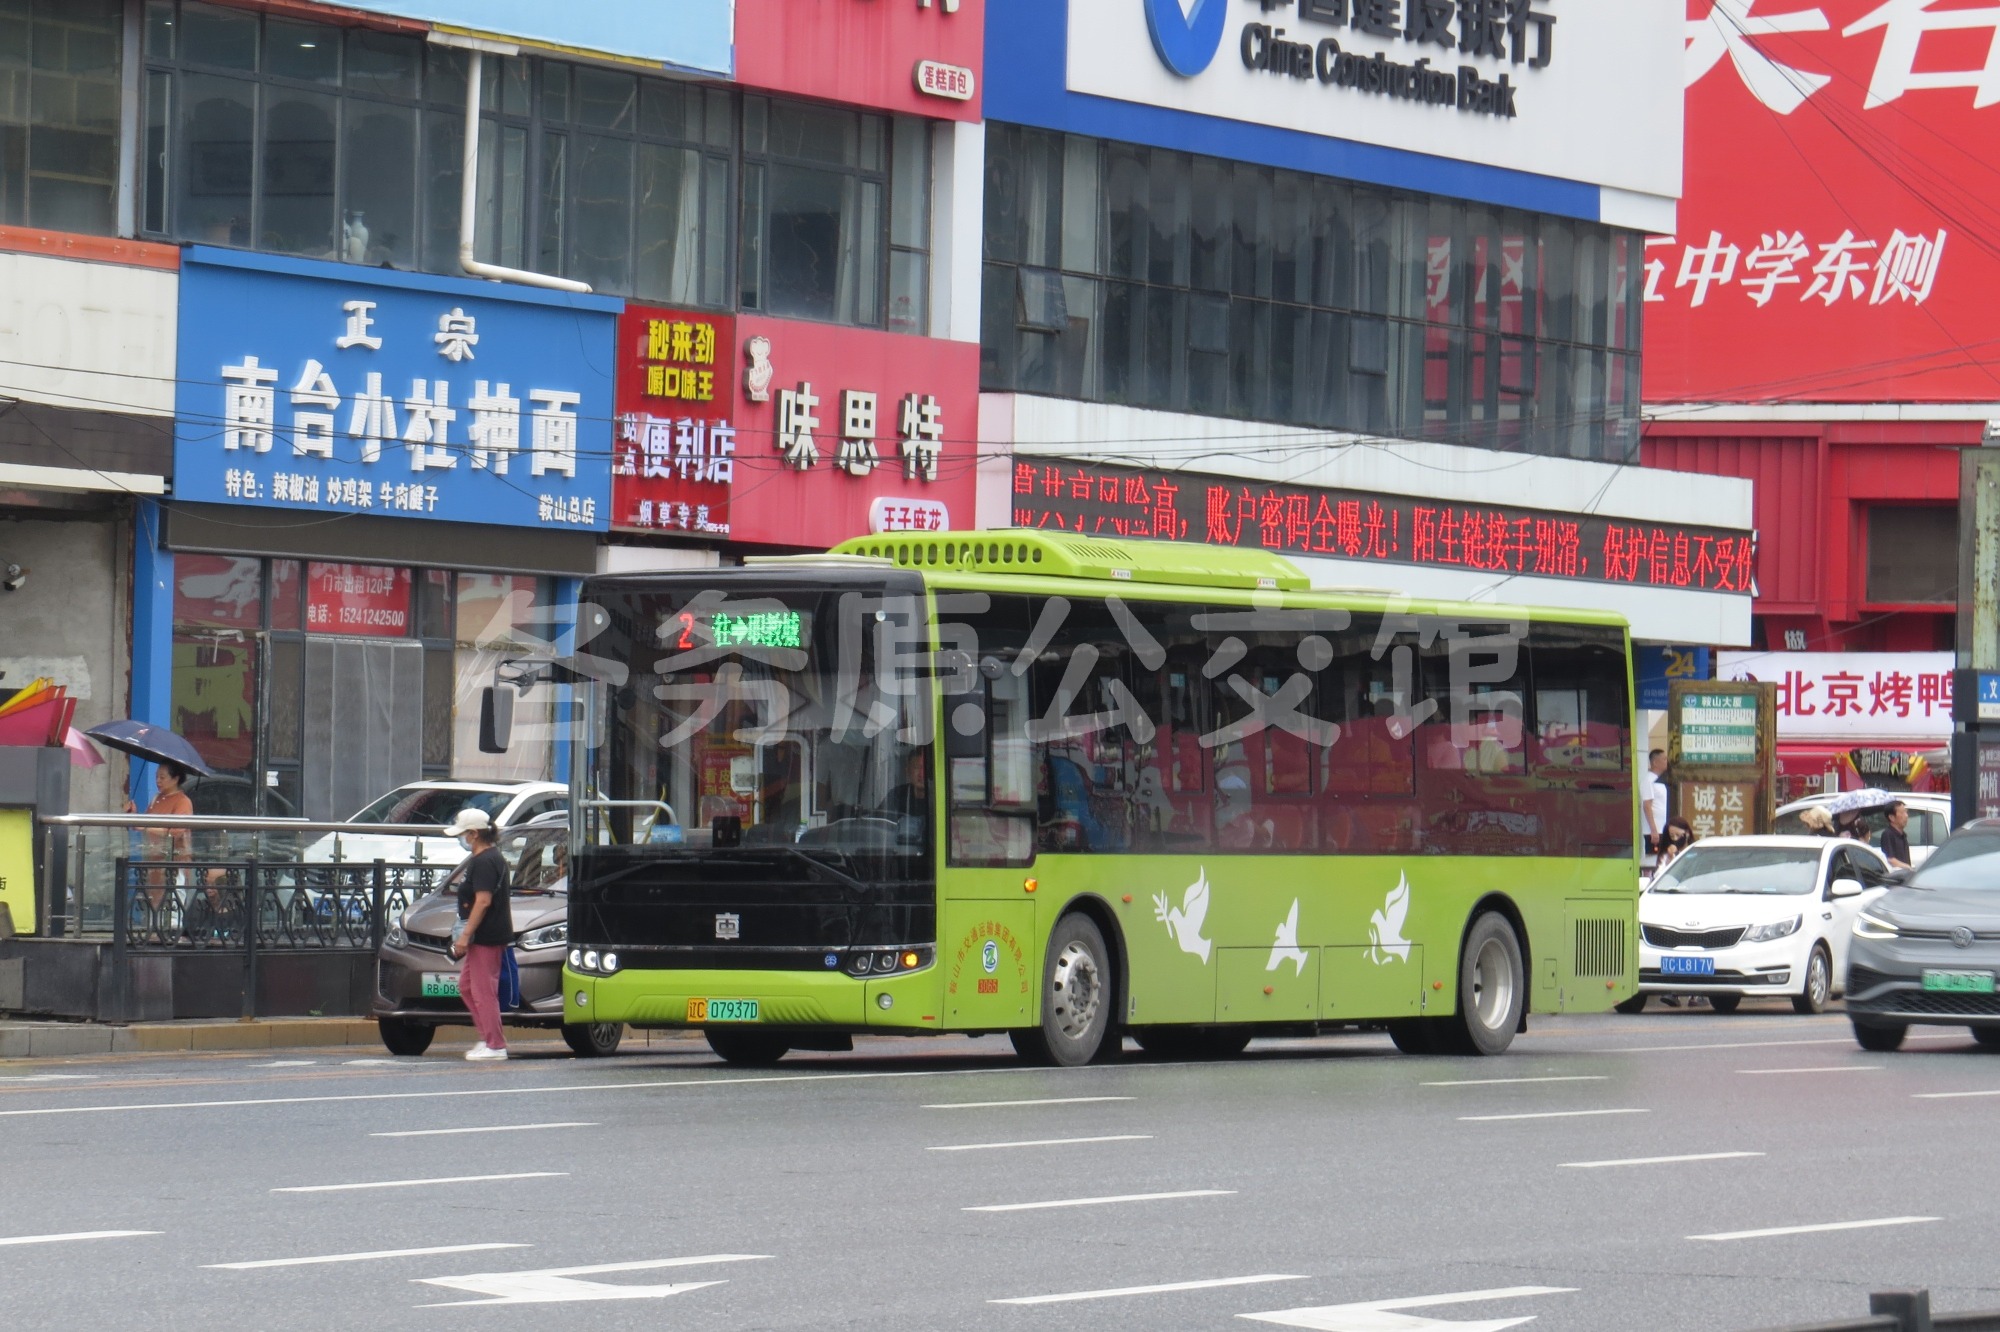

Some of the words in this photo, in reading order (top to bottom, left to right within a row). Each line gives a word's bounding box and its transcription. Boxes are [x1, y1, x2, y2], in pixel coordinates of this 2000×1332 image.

[924, 65, 967, 94] 蛋糕面包
[1240, 22, 1314, 79] China
[1315, 37, 1456, 106] Construction
[1457, 65, 1517, 118] Bank
[648, 319, 715, 365] 秒来劲
[775, 381, 943, 483] 味思特
[640, 413, 736, 484] 便利店
[327, 476, 372, 508] 炒鸡架
[538, 494, 596, 525] 鞍山总店
[640, 500, 709, 530] 烟草专卖
[883, 507, 942, 532] 王子麻花
[678, 613, 694, 648] 2
[1665, 651, 1696, 677] 24
[1701, 697, 1742, 708] 鞍山大厦
[1777, 670, 1953, 718] 北京烤鸭
[1692, 785, 1744, 812] 诚达
[1692, 814, 1744, 838] 学校
